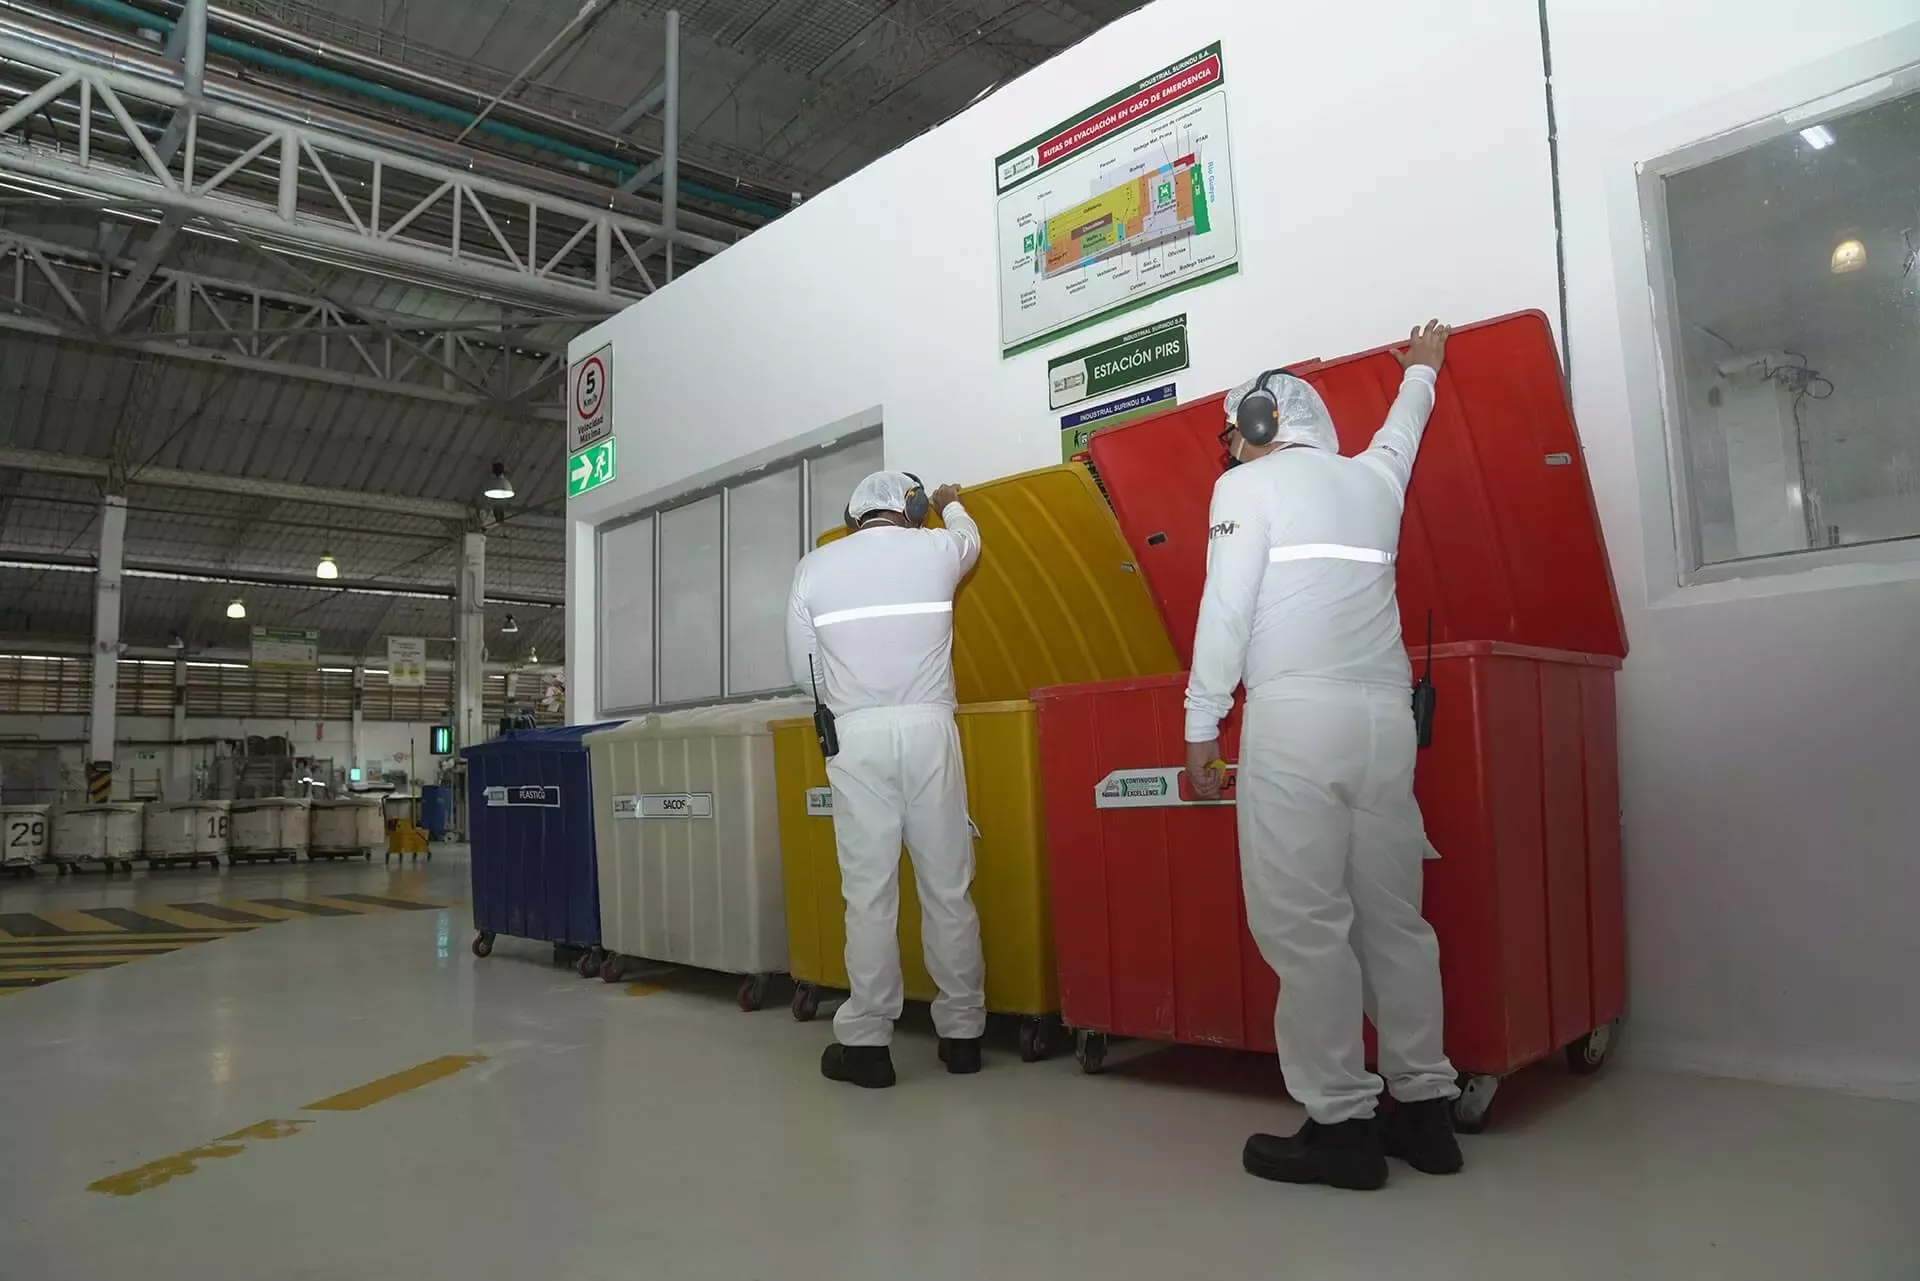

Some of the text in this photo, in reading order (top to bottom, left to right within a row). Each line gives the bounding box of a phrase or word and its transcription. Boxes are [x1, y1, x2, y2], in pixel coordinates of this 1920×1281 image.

[1139, 69, 1172, 89] INDUSTRIAL
[1172, 57, 1198, 73] SURINDU
[1043, 68, 1212, 158] RUTAS DE EVACUACIÓN EN CASO DE EMERGENCIA
[1123, 328, 1151, 342] INDUSTRIAL
[1094, 340, 1180, 380] ESTACIÓN PIRS
[586, 370, 595, 395] 5
[1080, 407, 1113, 422] INDUSTRIAL
[1114, 397, 1140, 412] SURINDU
[577, 413, 603, 435] Velocidad
[1210, 522, 1234, 540] TPM
[1126, 776, 1159, 784] CONTINUOUS
[1127, 789, 1160, 797] EXCELLENCE
[663, 799, 686, 811] SACOS
[11, 822, 45, 848] 29
[208, 816, 229, 838] 18
